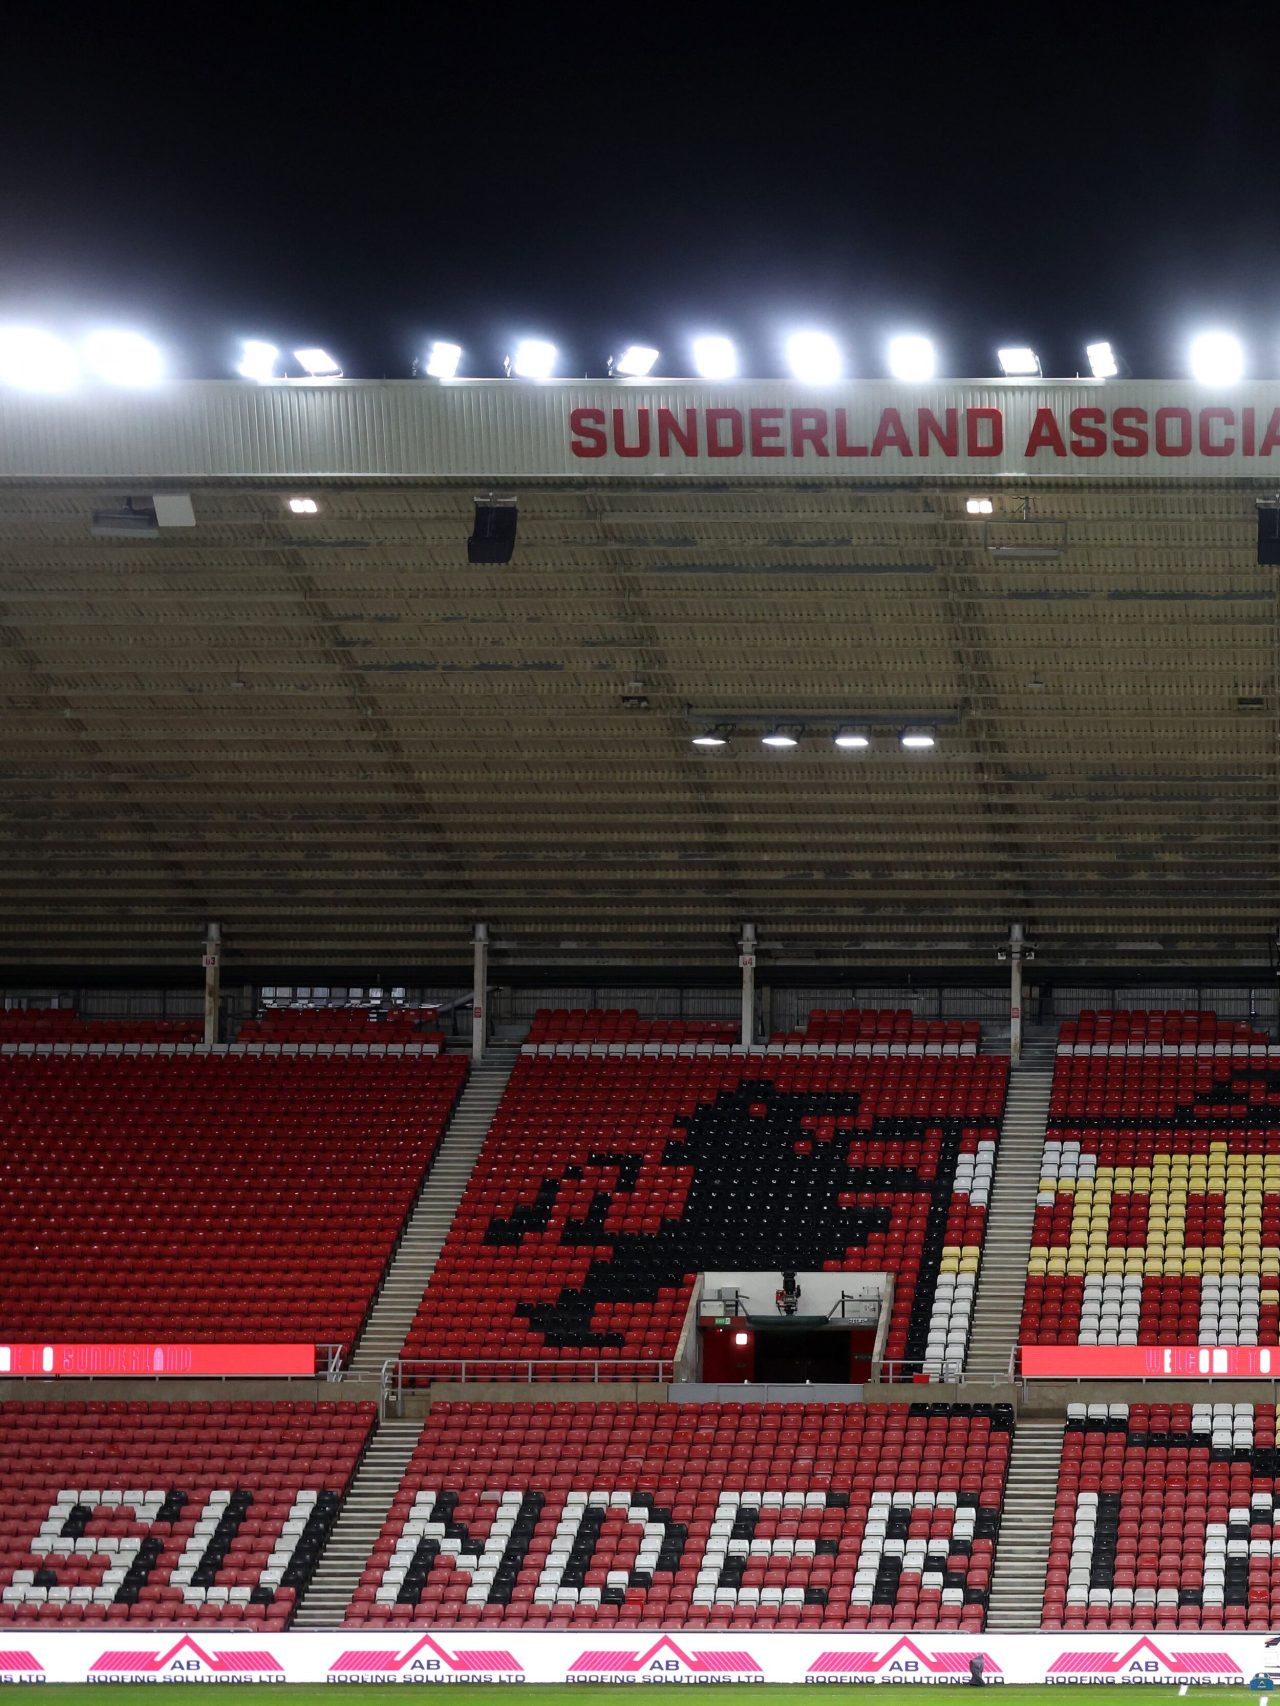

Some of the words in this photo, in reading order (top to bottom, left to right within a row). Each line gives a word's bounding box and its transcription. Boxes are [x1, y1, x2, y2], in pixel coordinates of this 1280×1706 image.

[570, 408, 1003, 458] SUNDERLAND
[172, 1660, 200, 1670] AB
[411, 1660, 440, 1670] AB
[650, 1660, 679, 1670] AB
[889, 1661, 918, 1671] AB
[1128, 1661, 1158, 1672] AB
[87, 1675, 157, 1683] ROOFING
[163, 1675, 252, 1683] SOLUTIONS
[259, 1675, 286, 1683] LTD
[327, 1675, 397, 1683] ROOFING
[403, 1675, 492, 1683] SOLUTIONS
[499, 1675, 526, 1683] LTD
[566, 1675, 636, 1683] ROOFING
[642, 1675, 731, 1683] SOLUTIONS
[738, 1675, 765, 1683] LTD
[805, 1676, 875, 1684] ROOFING
[1045, 1676, 1115, 1684] ROOFING
[1121, 1676, 1210, 1684] SOLUTIONS
[1217, 1676, 1244, 1684] LTD
